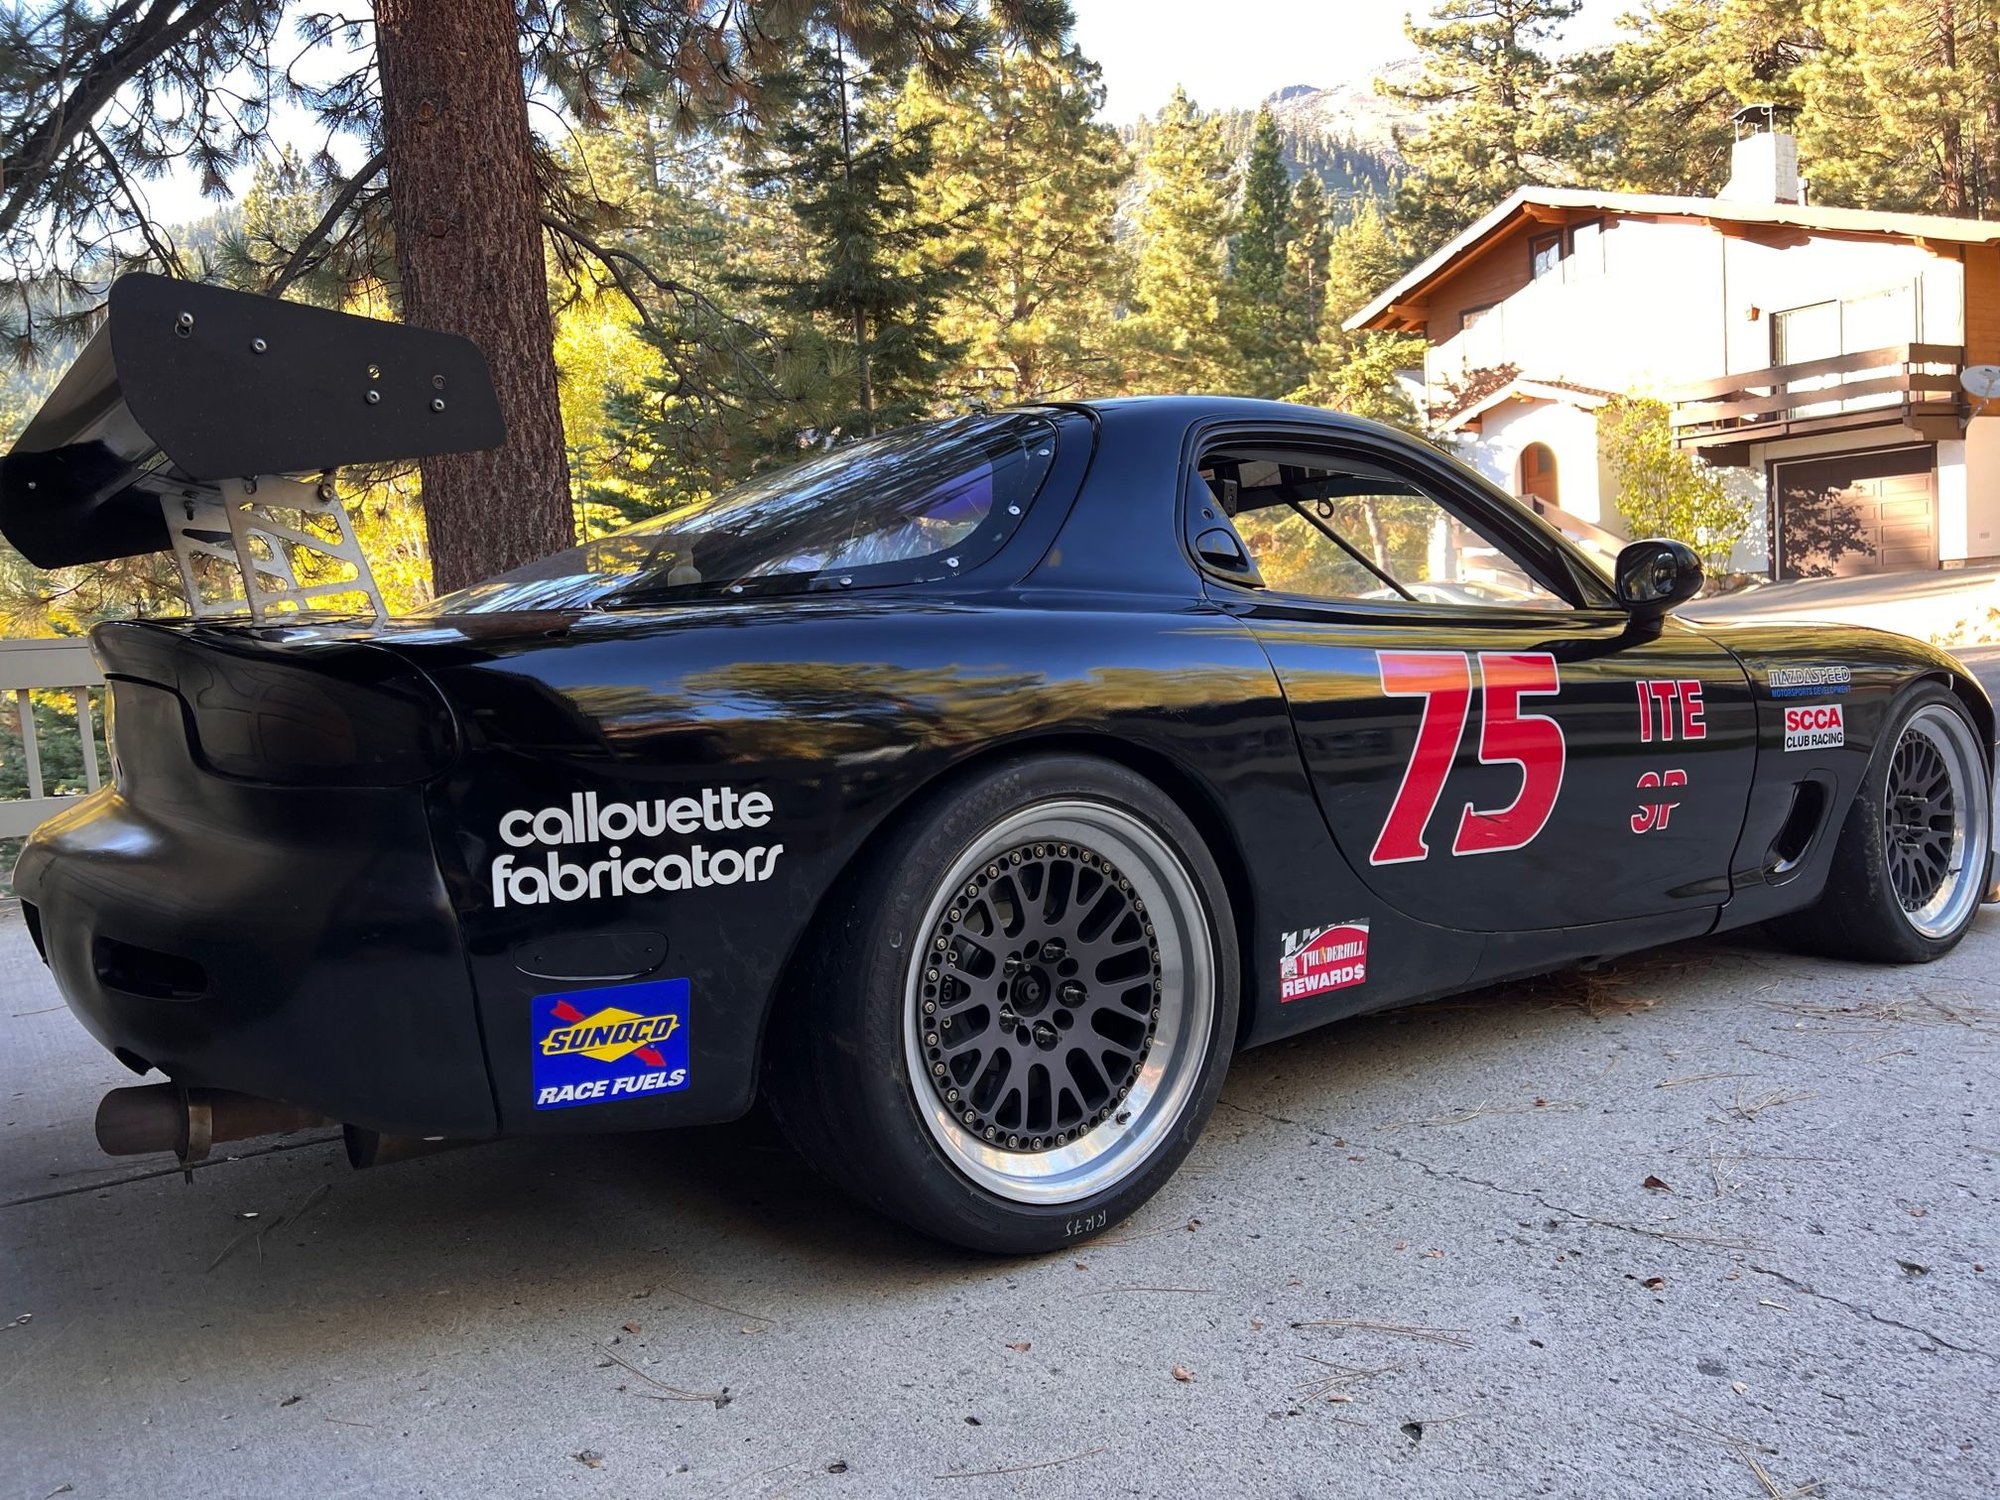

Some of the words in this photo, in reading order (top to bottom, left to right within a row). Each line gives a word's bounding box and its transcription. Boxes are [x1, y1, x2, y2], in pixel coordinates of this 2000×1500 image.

[1768, 666, 1851, 687] MAZDASPEED
[1636, 680, 1706, 742] ITE
[1787, 708, 1842, 732] SCCA
[1369, 650, 1566, 866] 75
[1786, 736, 1810, 748] CLUB
[1811, 732, 1843, 745] RACING
[499, 787, 774, 847] callouette
[492, 844, 784, 908] fabricators
[548, 1018, 675, 1050] SUNOCO
[537, 1081, 607, 1105] RACE
[611, 1069, 686, 1095] FUELS
